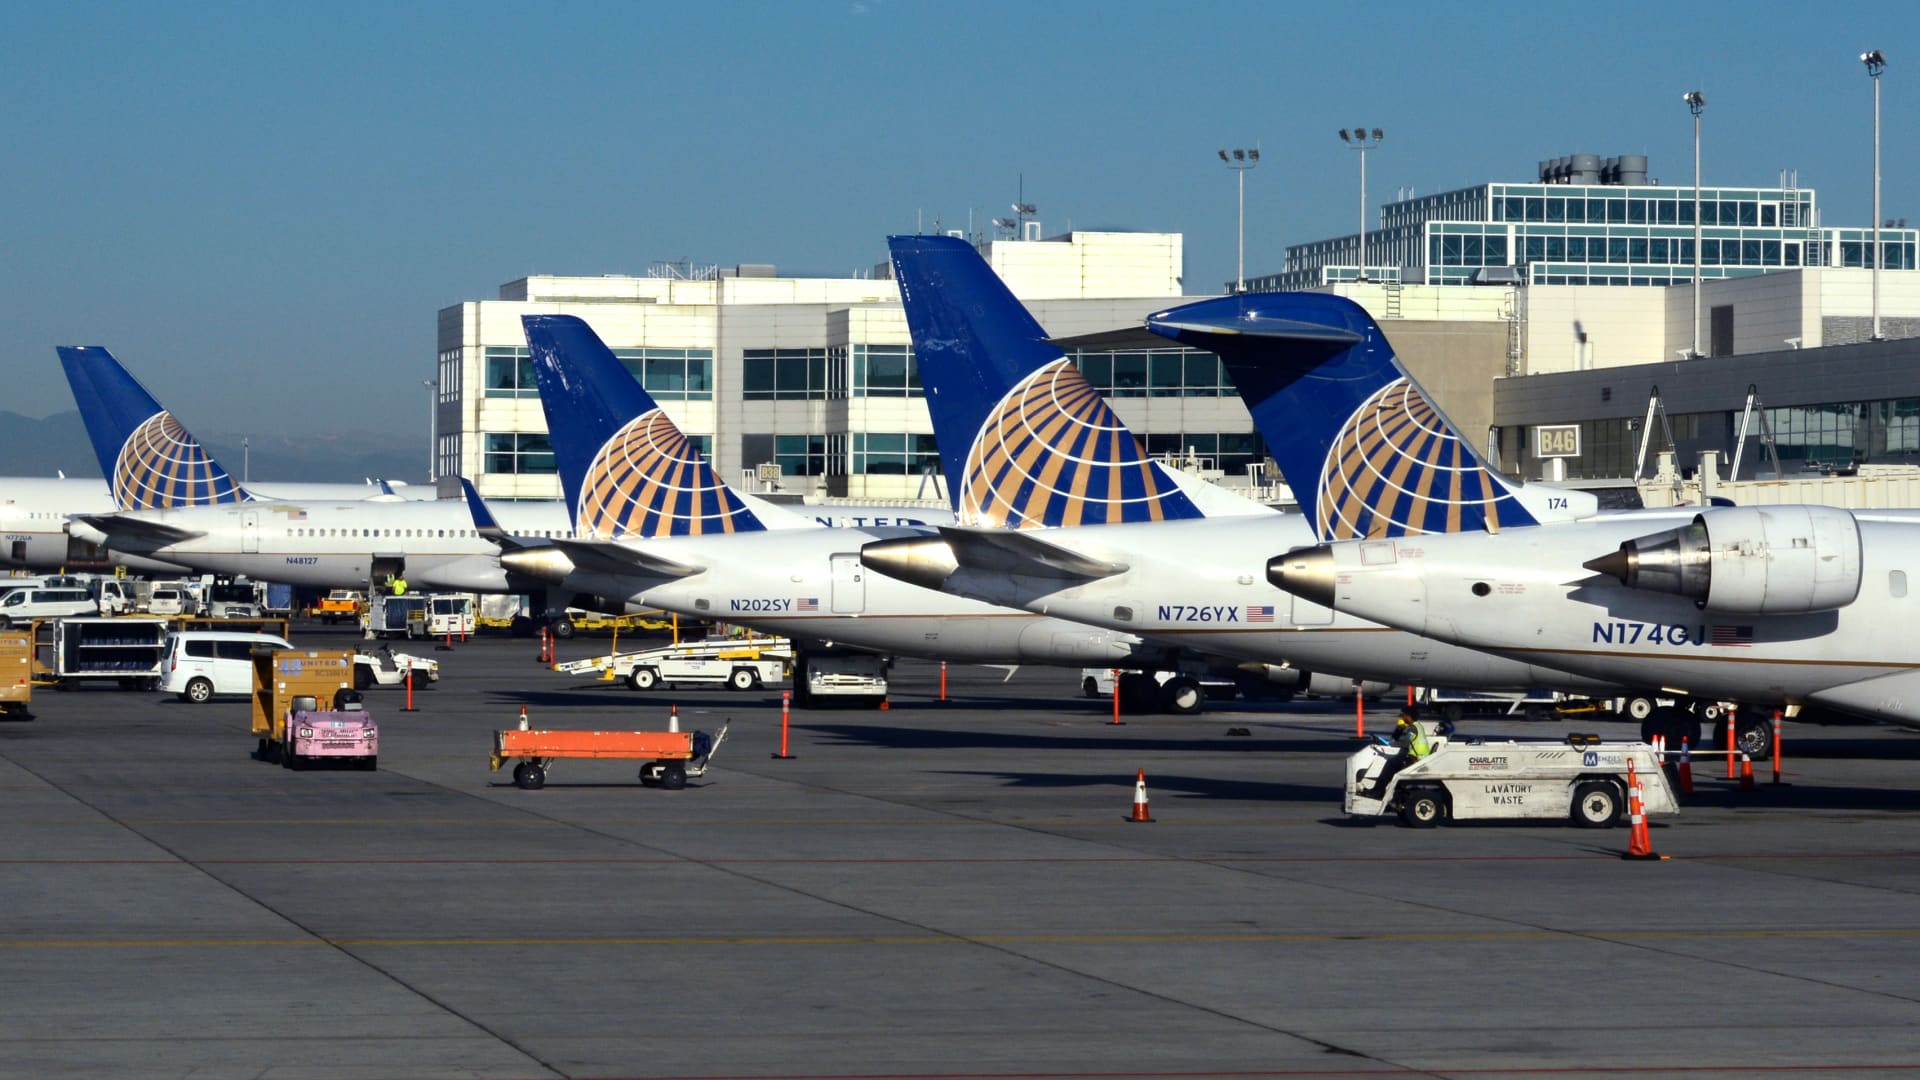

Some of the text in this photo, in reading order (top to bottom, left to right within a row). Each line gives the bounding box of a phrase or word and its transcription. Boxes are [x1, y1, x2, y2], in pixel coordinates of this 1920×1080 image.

[1541, 430, 1575, 453] B46
[762, 465, 779, 479] B38
[1547, 498, 1568, 509] 174
[286, 556, 318, 565] N48127
[730, 599, 791, 611] N202SY
[1158, 605, 1239, 622] N726YX
[1592, 622, 1706, 647] N174GJ
[1485, 784, 1533, 794] LAVATORY
[1493, 796, 1524, 805] WASTE
